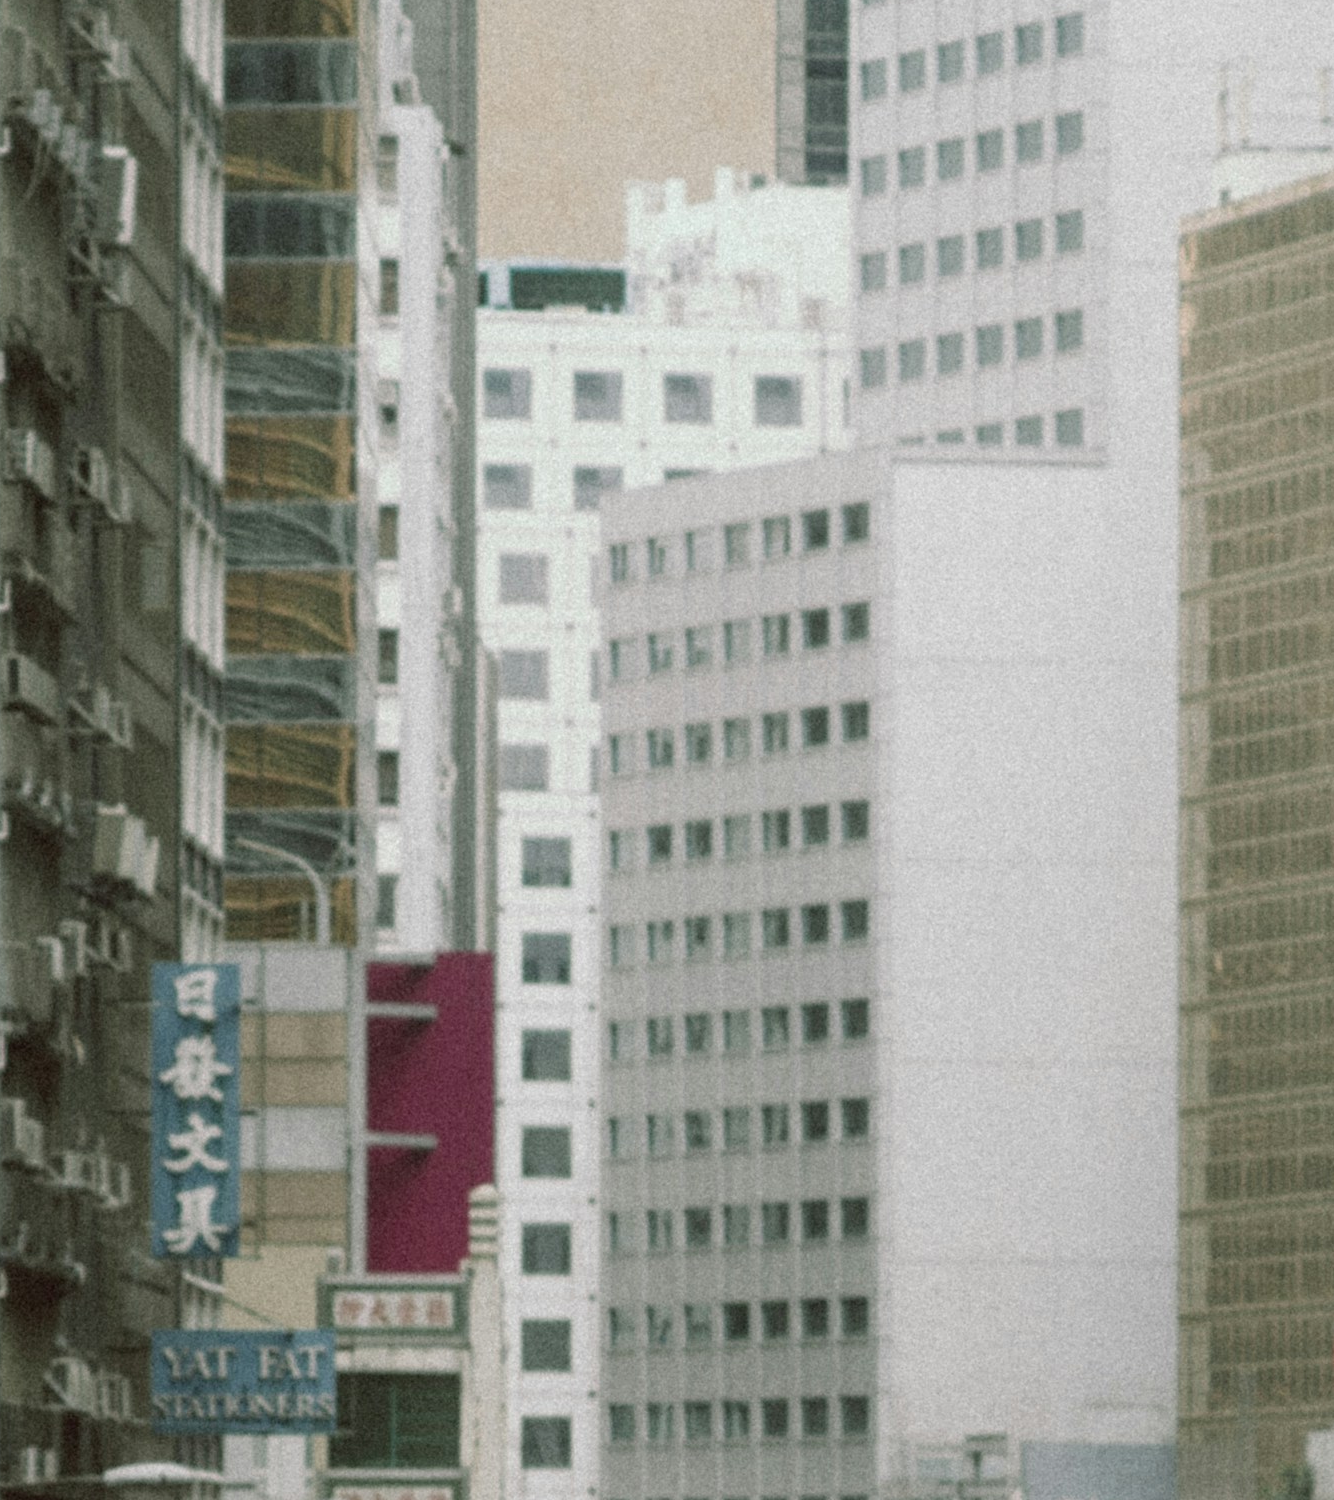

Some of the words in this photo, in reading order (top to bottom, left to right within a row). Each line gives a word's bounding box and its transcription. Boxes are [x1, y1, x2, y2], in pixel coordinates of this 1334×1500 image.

[161, 1345, 237, 1380] YAT
[257, 1344, 328, 1380] FAT
[151, 1391, 337, 1420] STATIONERS
